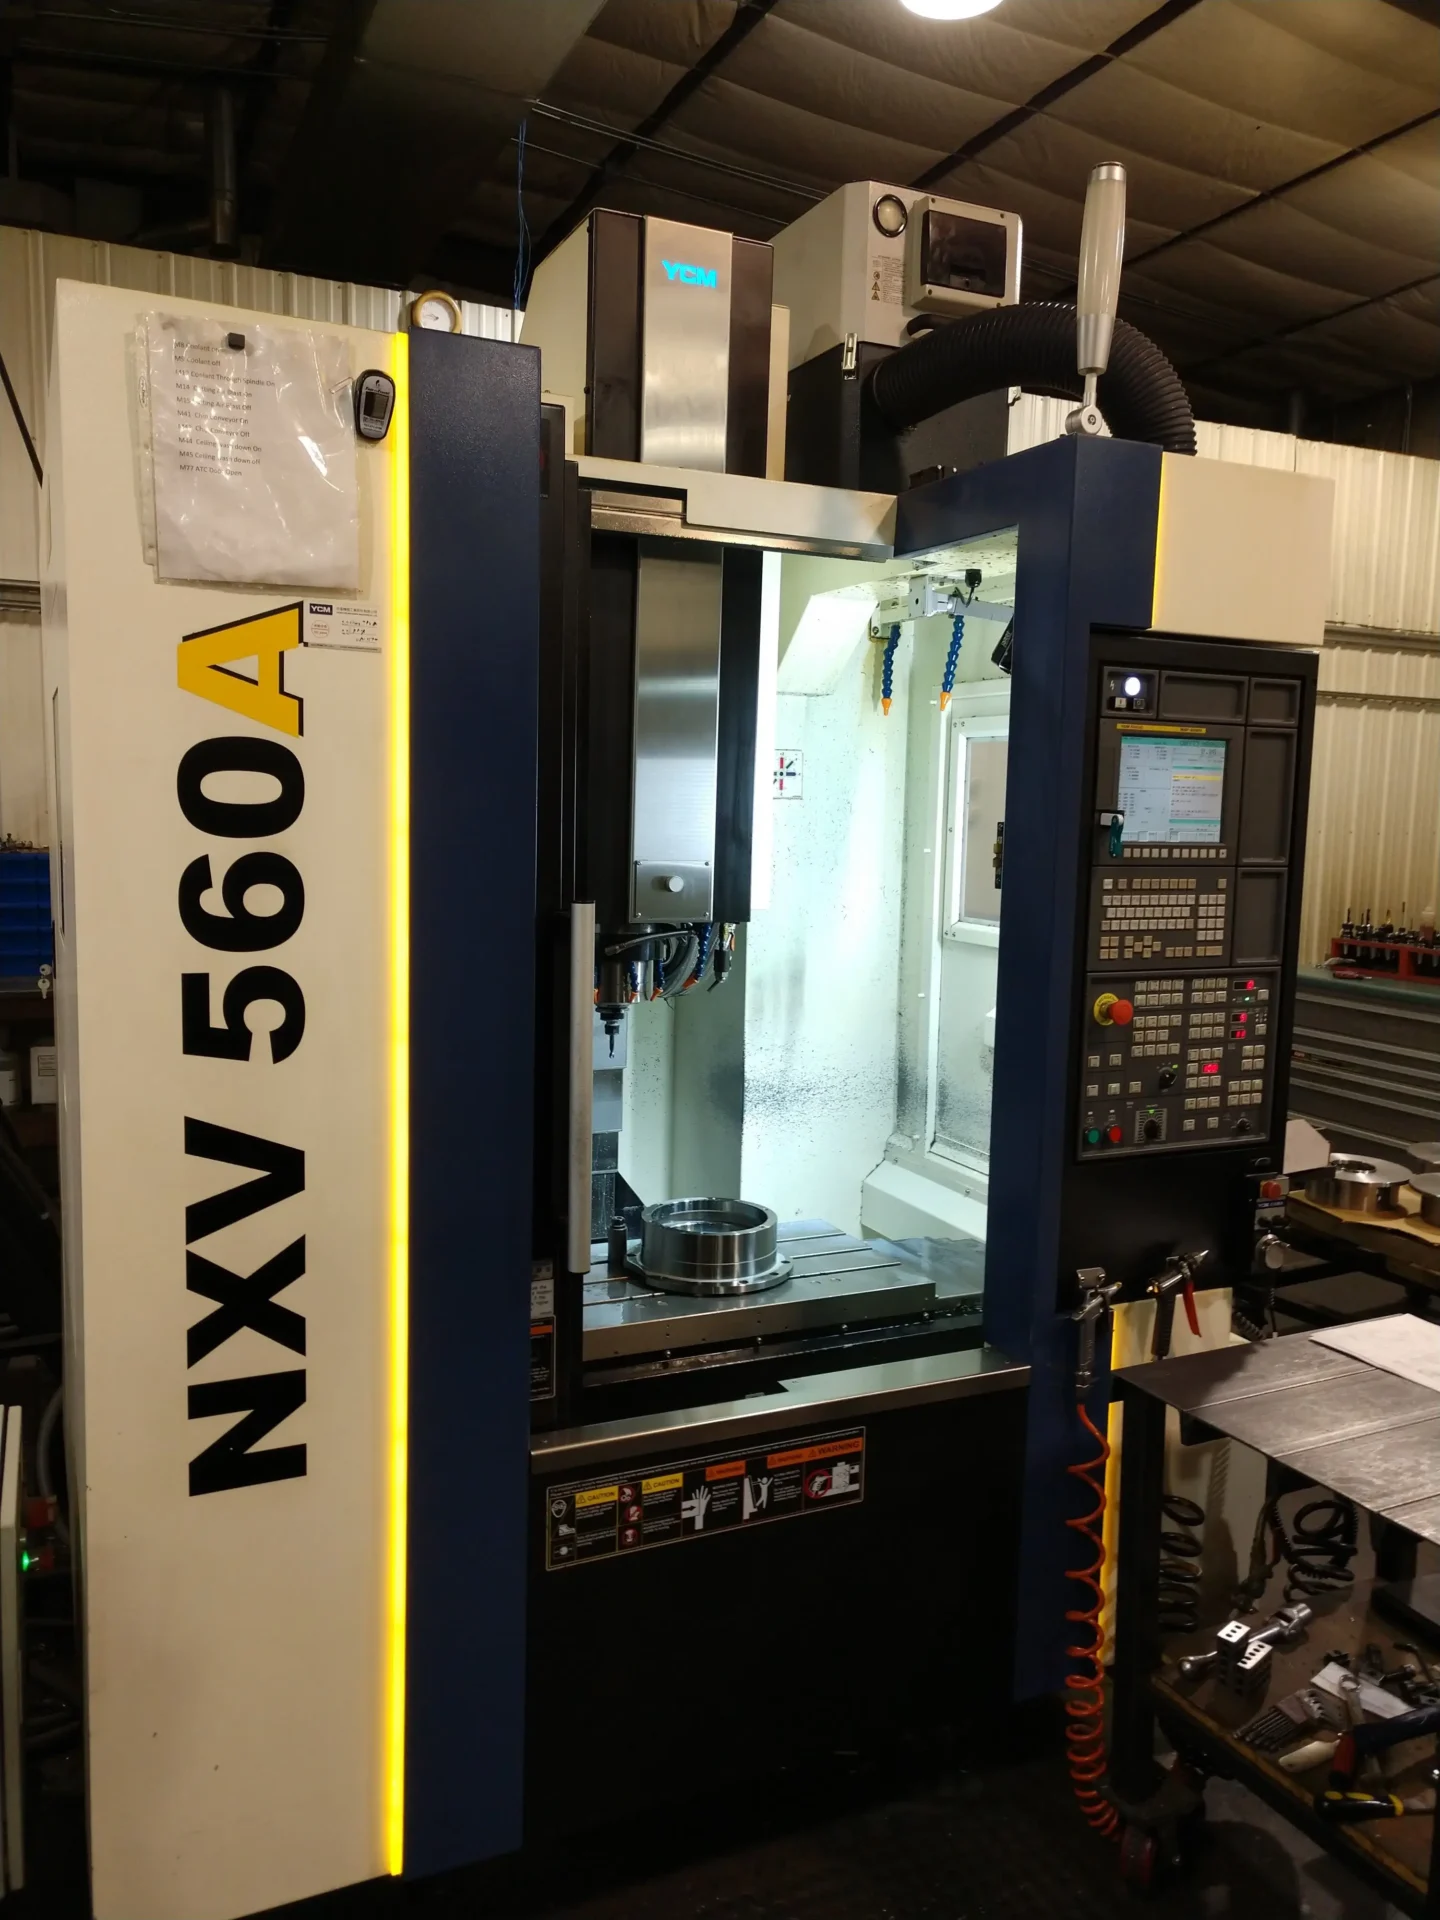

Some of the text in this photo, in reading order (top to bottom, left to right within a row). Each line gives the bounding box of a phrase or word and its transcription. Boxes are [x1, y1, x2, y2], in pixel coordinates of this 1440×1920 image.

[661, 260, 717, 288] YCM
[310, 605, 331, 613] YCM
[176, 602, 307, 1497] NXV 560A
[818, 1440, 860, 1455] WARNING
[652, 1478, 680, 1489] CAUTION
[587, 1490, 615, 1502] CAUTION
